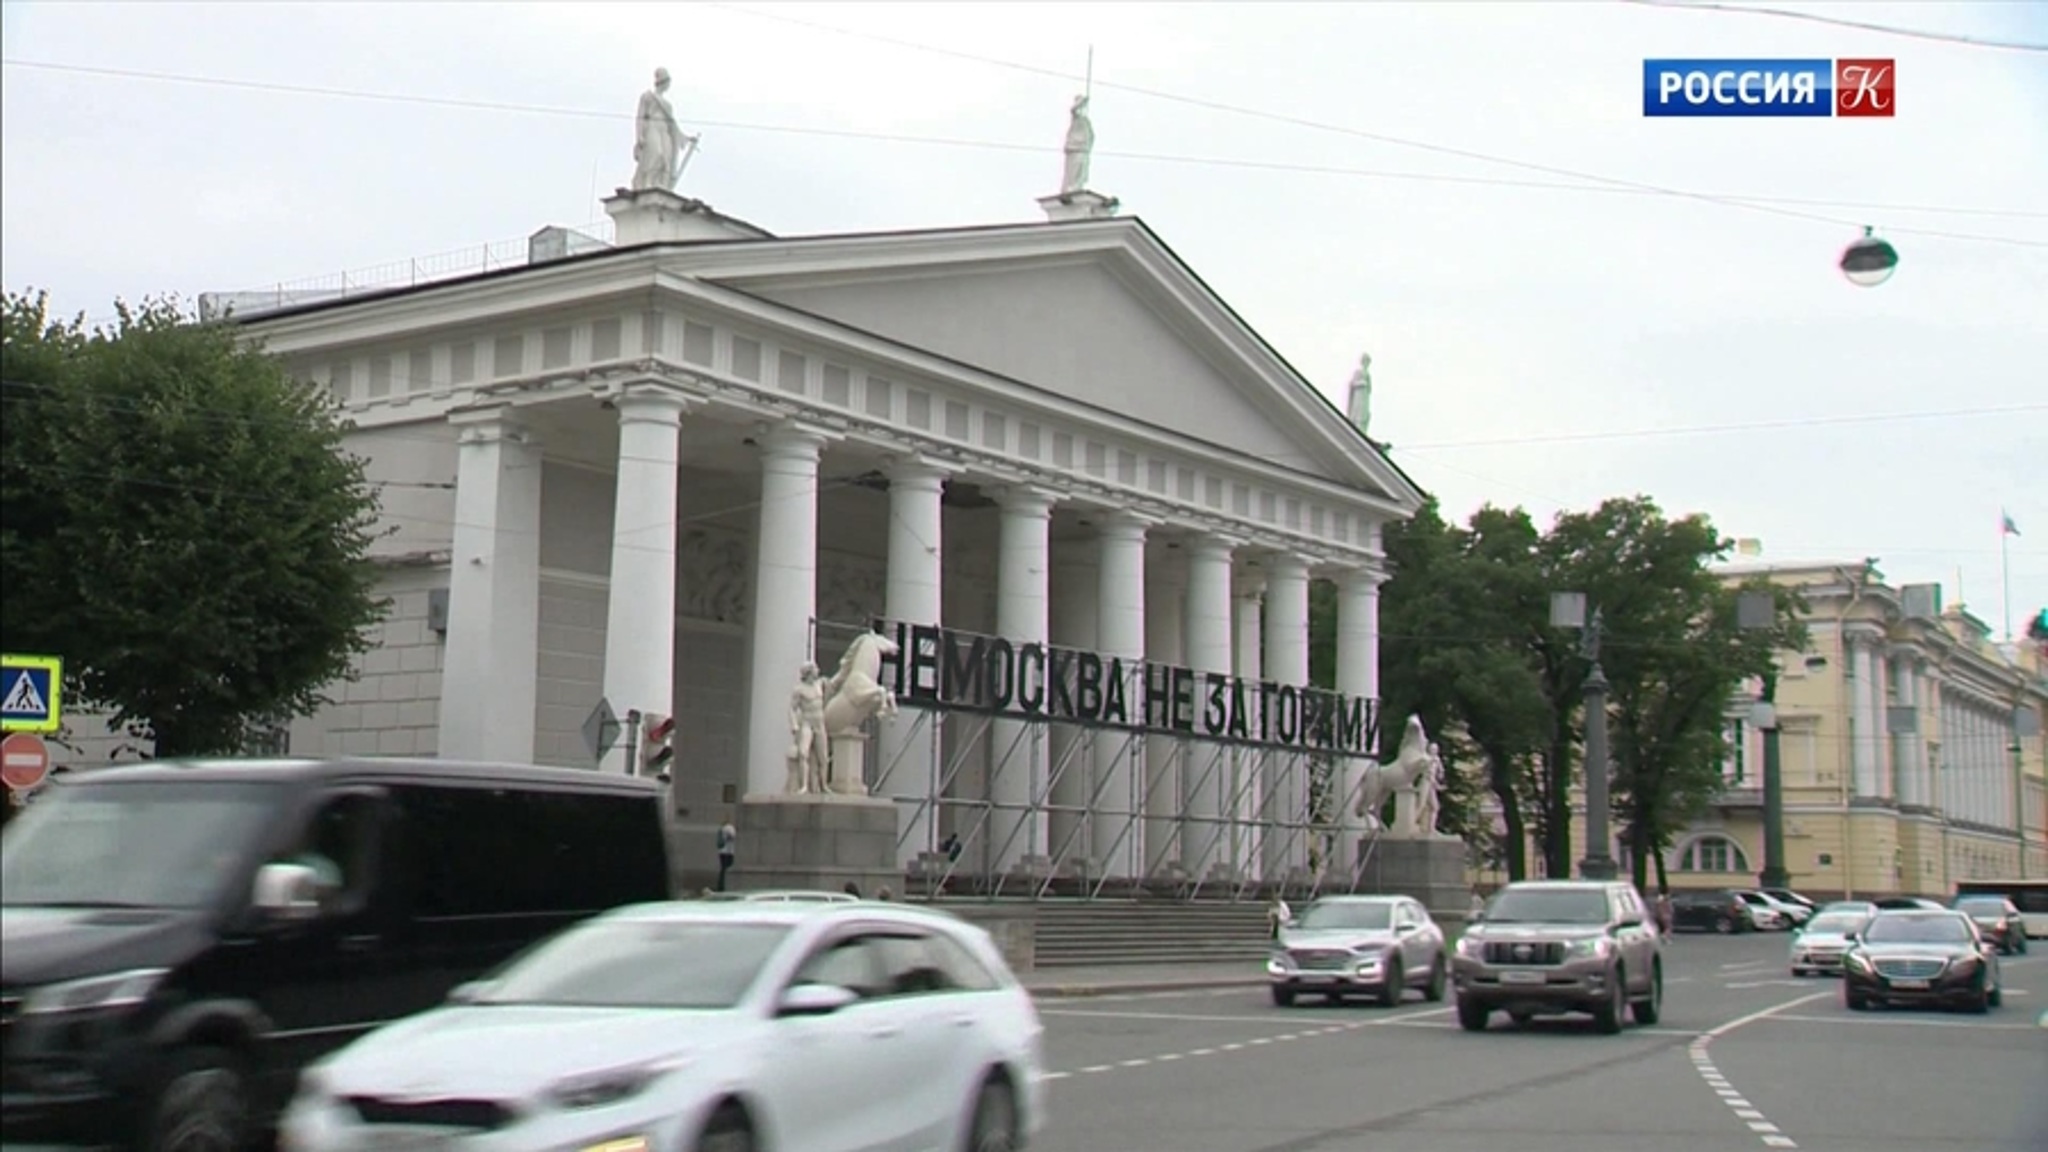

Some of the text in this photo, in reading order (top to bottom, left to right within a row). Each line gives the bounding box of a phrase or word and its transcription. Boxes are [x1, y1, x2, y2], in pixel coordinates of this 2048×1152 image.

[874, 618, 1382, 754] НЕМОСКВА НЕ ЗА ГОРАМИ
